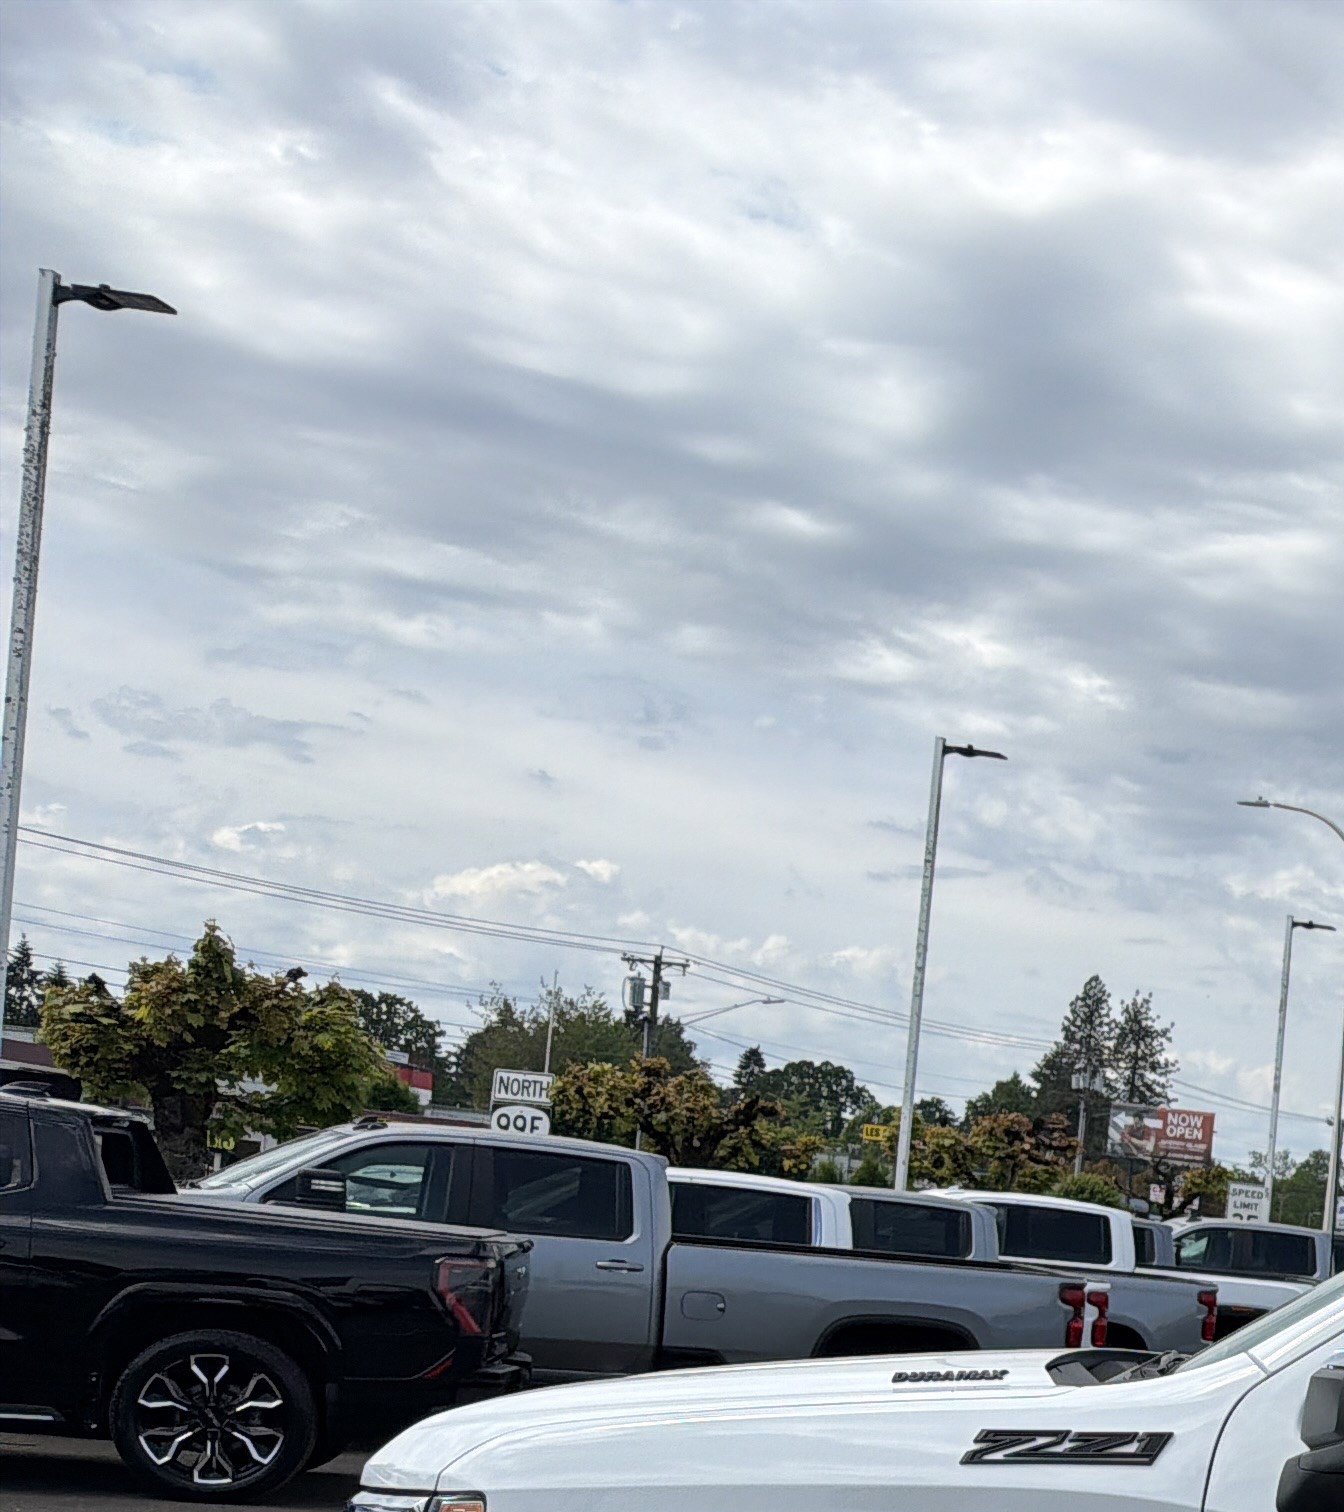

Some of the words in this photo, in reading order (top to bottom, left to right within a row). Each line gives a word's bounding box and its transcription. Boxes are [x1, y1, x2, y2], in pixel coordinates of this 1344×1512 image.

[497, 1076, 551, 1098] NORTH
[1167, 1112, 1204, 1128] NOW
[1166, 1125, 1203, 1141] OPEN
[1232, 1187, 1264, 1200] SPEED
[1233, 1200, 1259, 1211] LIMIT
[892, 1369, 1009, 1384] DURAMAX
[959, 1429, 1174, 1466] Z71
